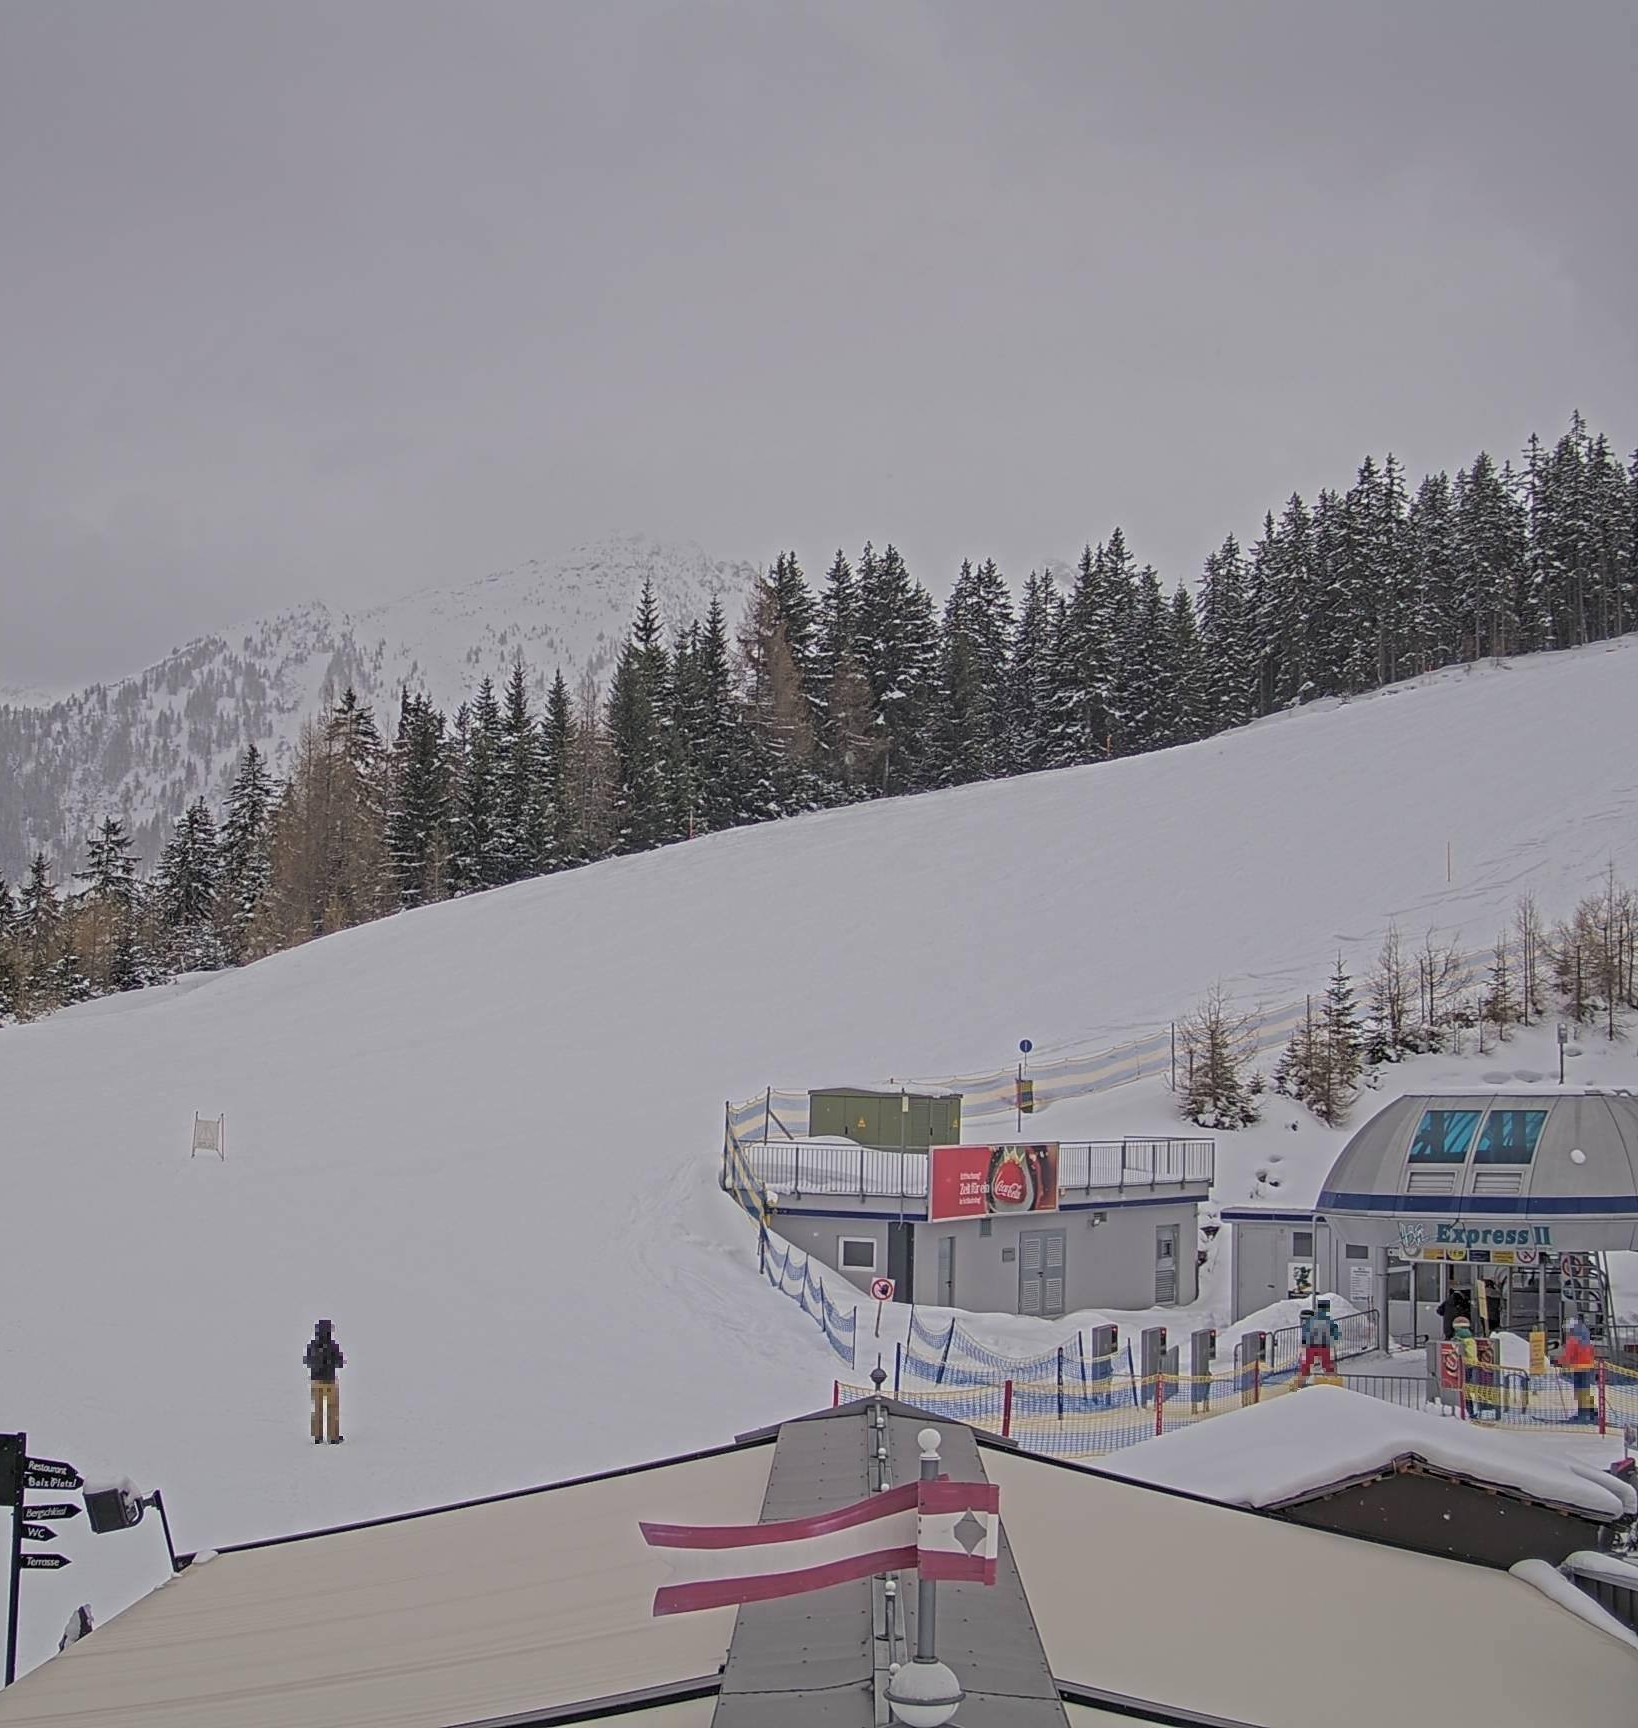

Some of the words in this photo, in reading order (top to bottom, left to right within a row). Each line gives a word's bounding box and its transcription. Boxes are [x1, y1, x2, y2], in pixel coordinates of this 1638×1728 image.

[1436, 1223, 1529, 1249] Express
[27, 1527, 46, 1539] WC
[26, 1556, 60, 1567] Terrasse
